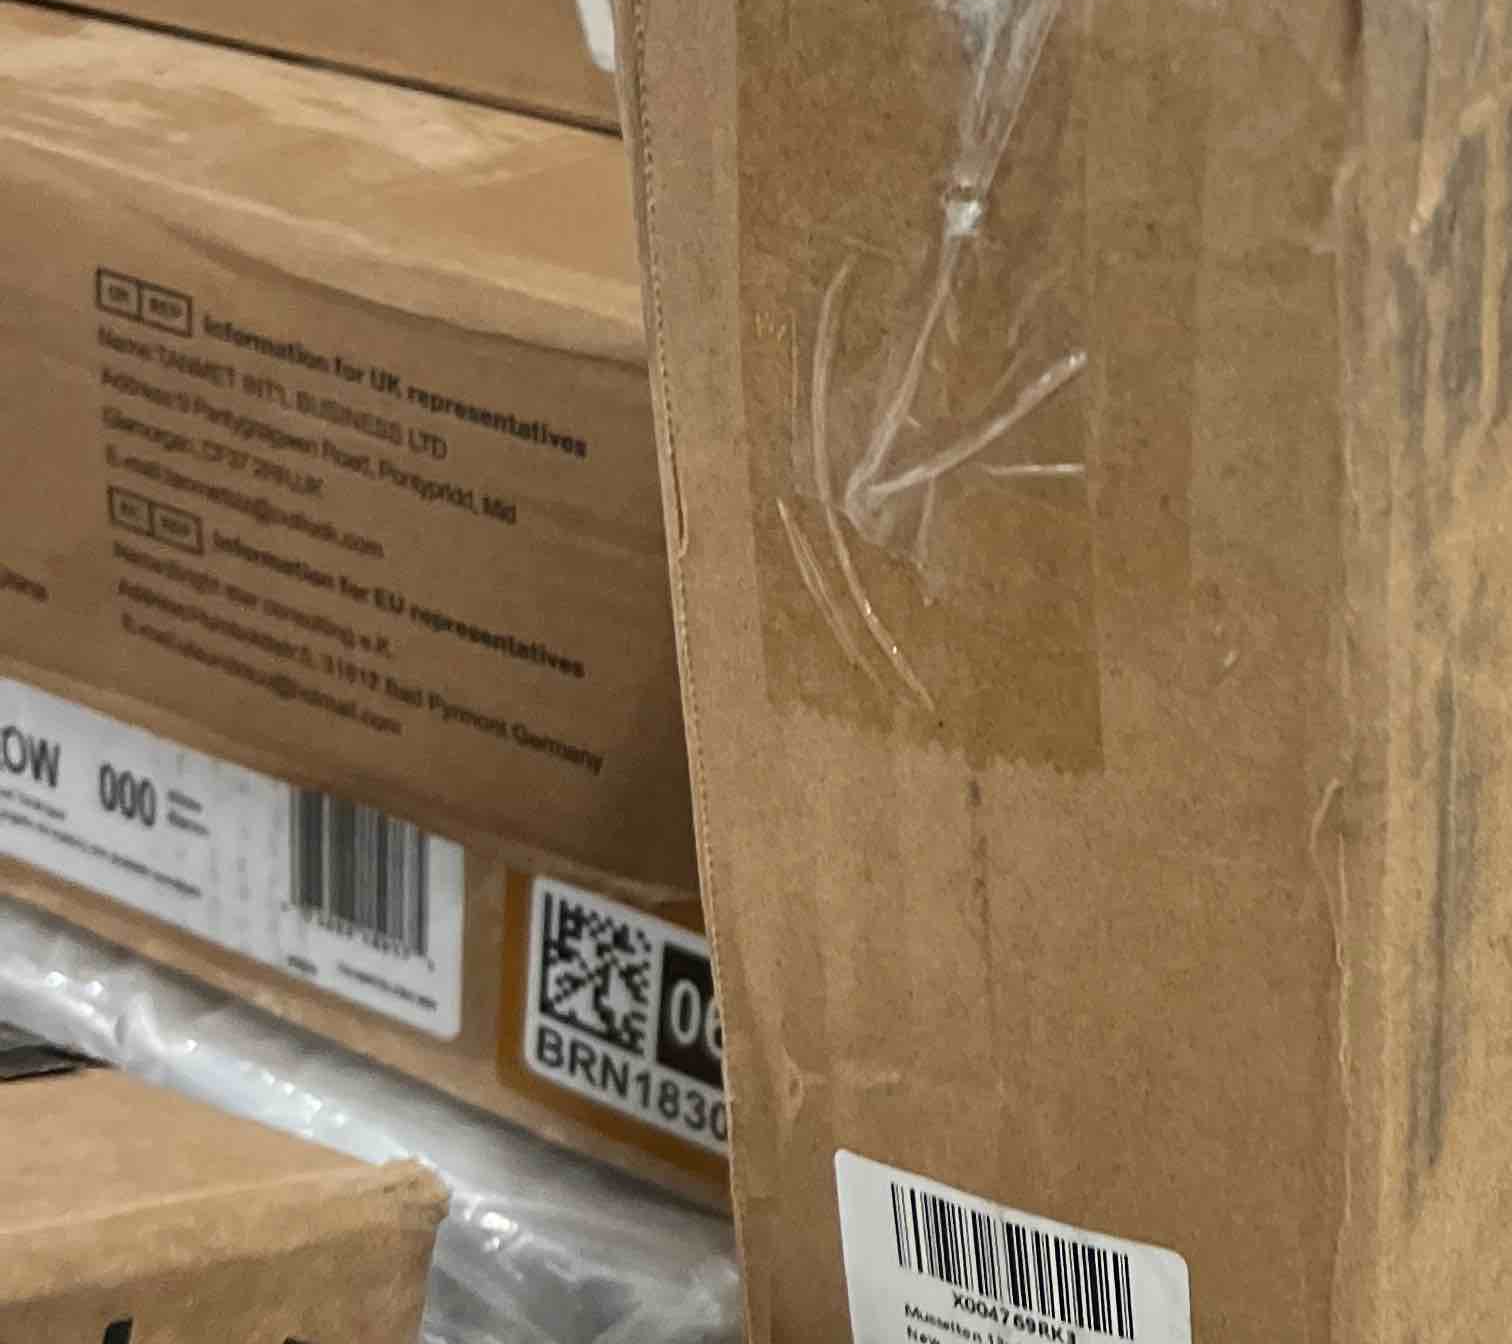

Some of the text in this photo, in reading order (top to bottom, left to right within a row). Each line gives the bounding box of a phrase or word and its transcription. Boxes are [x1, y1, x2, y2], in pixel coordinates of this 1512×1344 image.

[203, 310, 330, 373] Information
[334, 356, 365, 384] for
[408, 385, 588, 459] representatives
[408, 428, 448, 460] LTD
[339, 575, 370, 603] for
[373, 587, 405, 615] EU
[409, 604, 586, 679] representatives
[0, 725, 61, 789] OW
[511, 721, 603, 777] Germany
